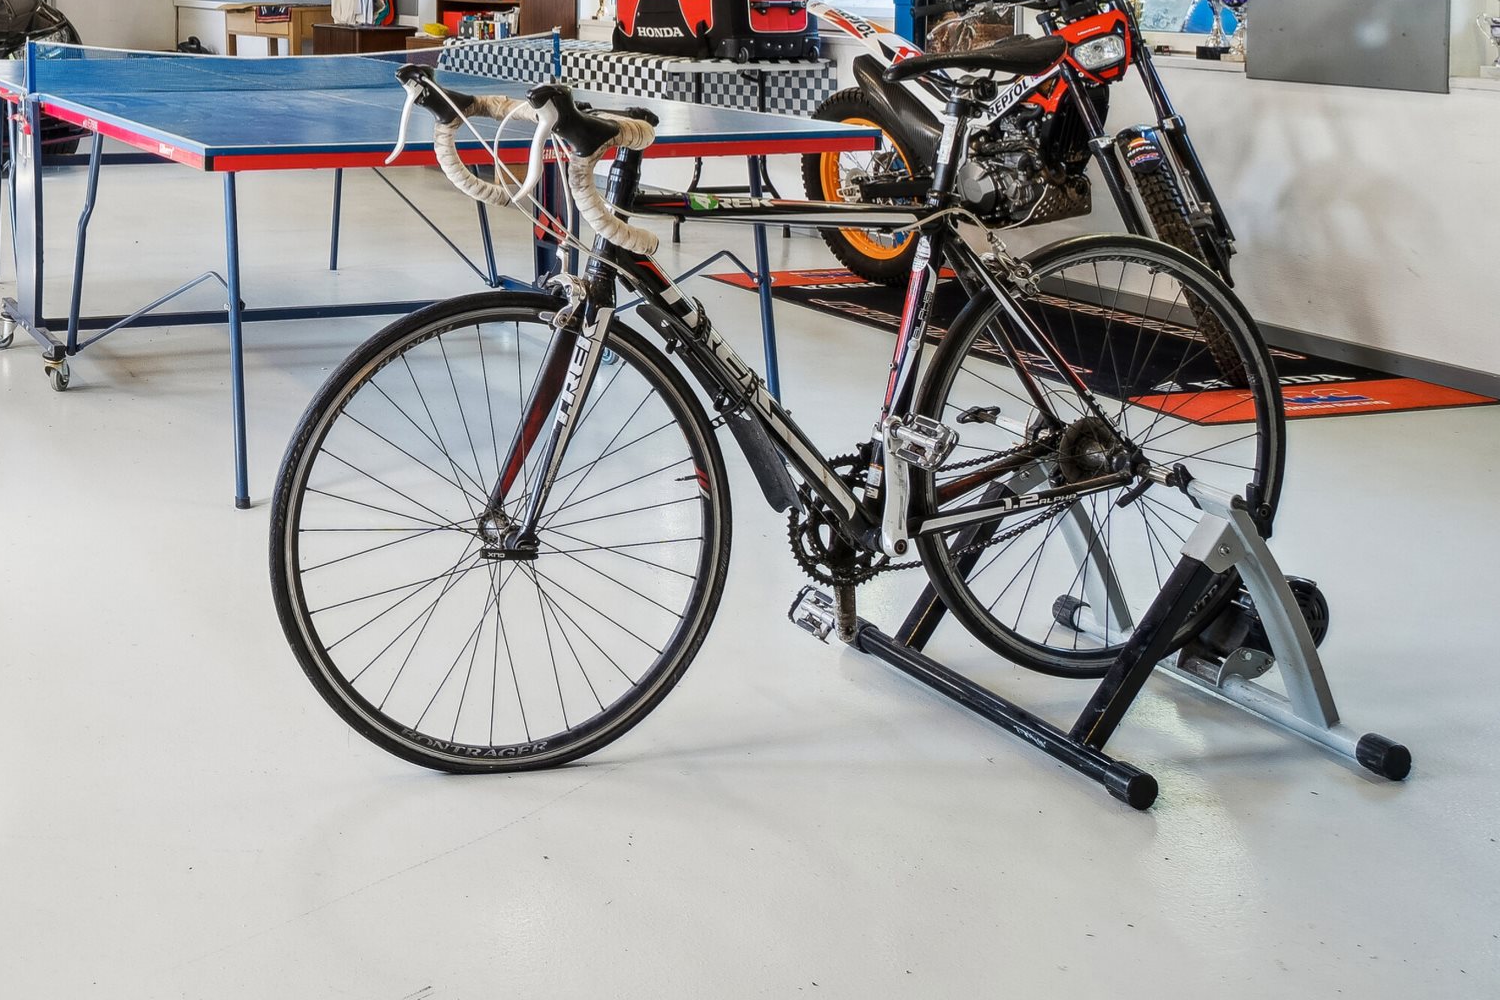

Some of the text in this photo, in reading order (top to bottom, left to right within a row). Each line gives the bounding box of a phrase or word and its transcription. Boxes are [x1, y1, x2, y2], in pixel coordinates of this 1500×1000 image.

[637, 27, 684, 37] HONDA
[988, 81, 1029, 120] REPSOL
[557, 322, 598, 427] TREK
[1003, 493, 1077, 511] 1.2 ALPHA
